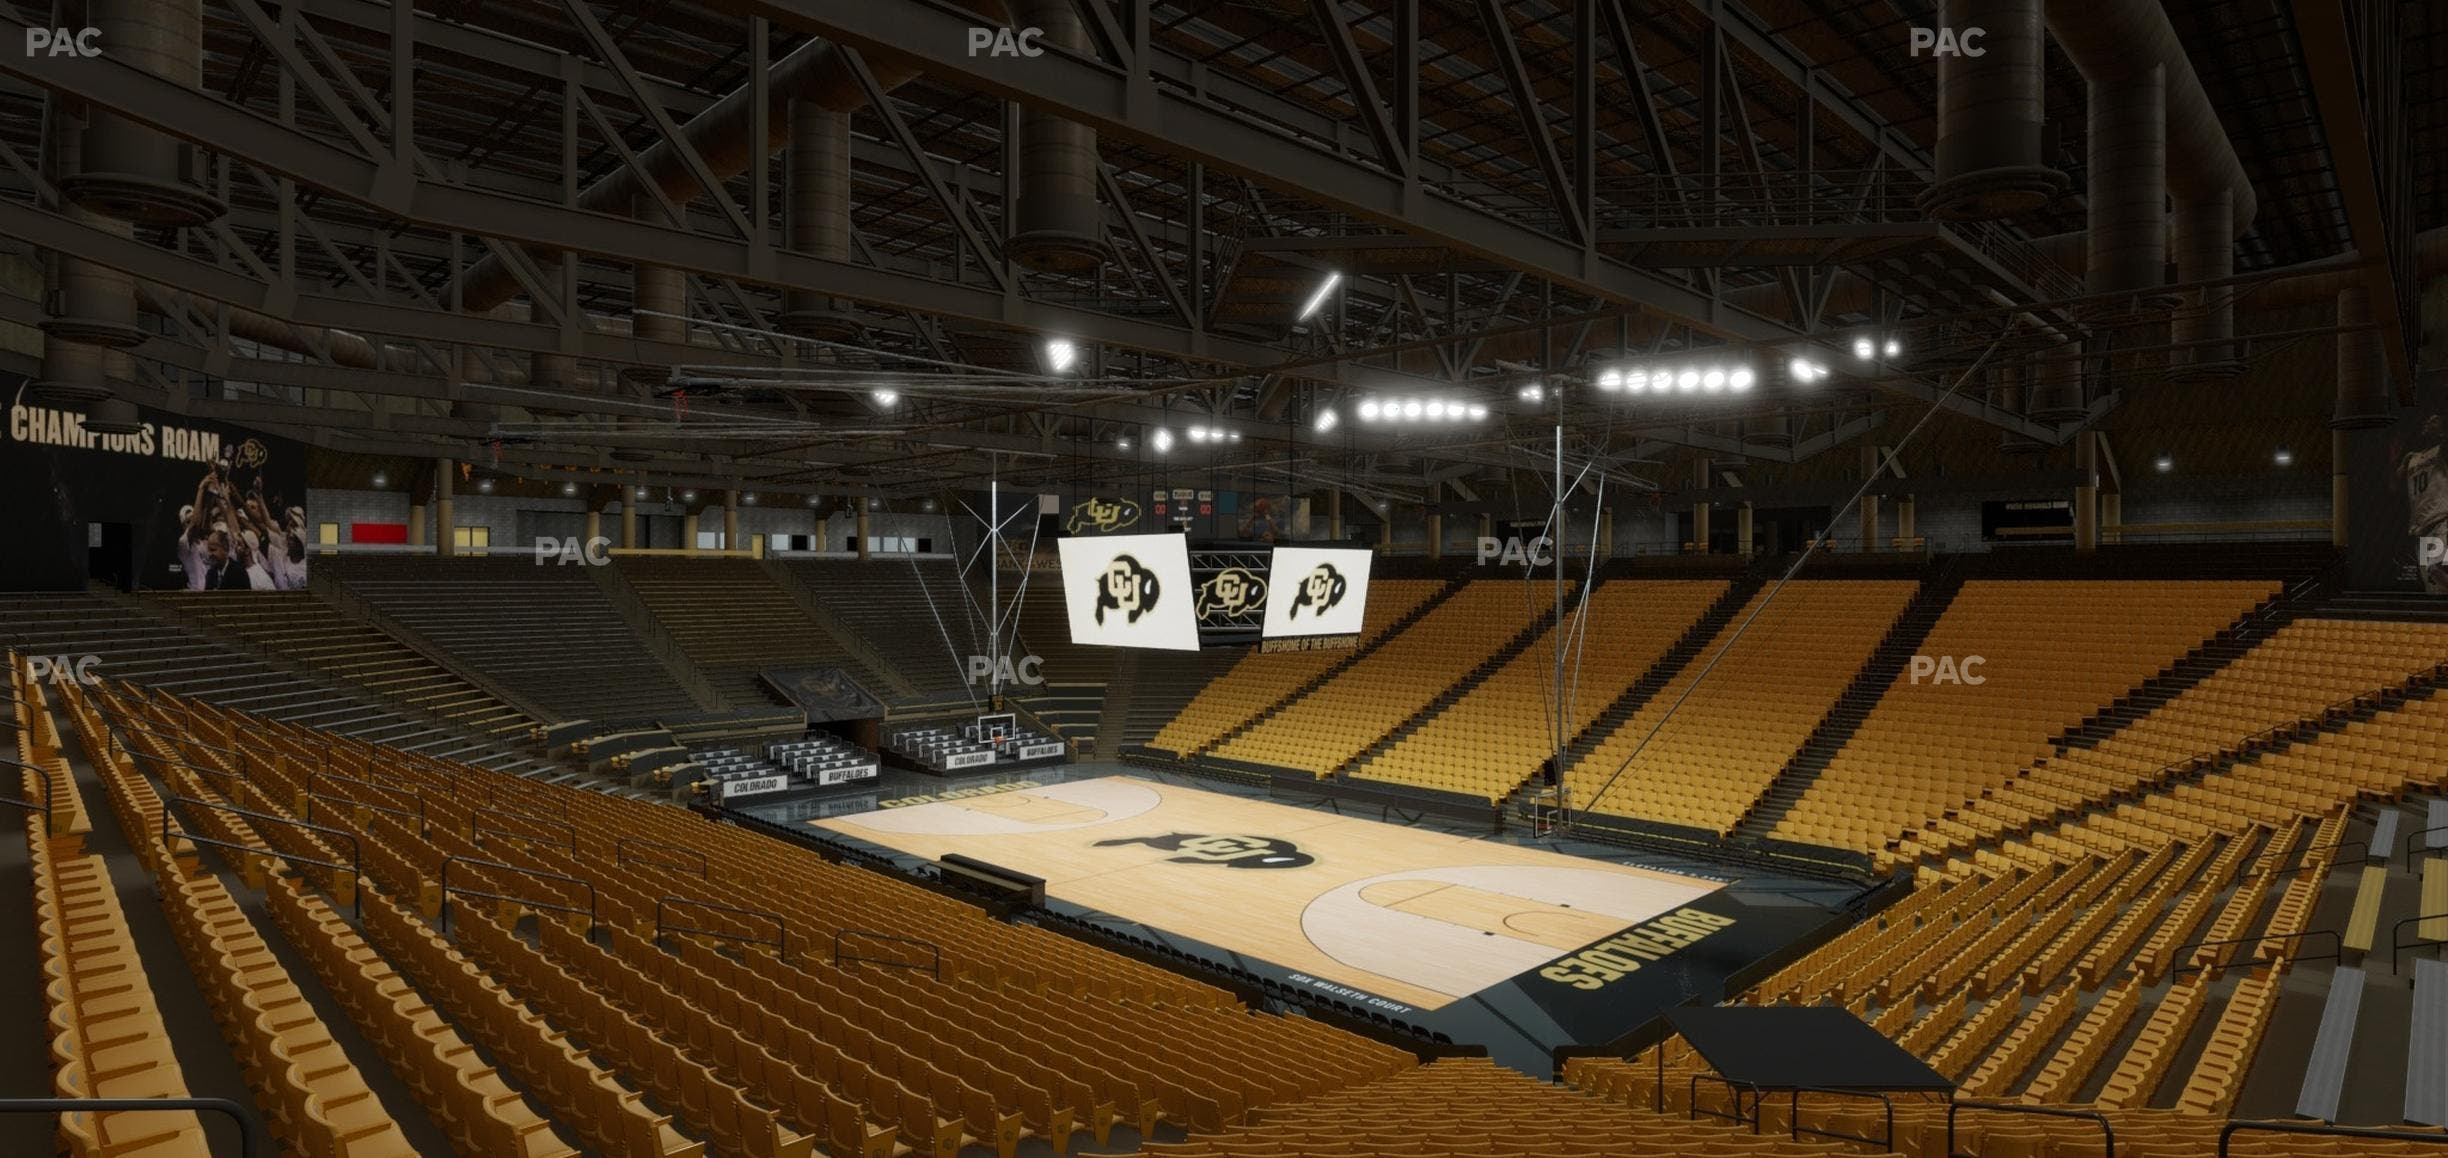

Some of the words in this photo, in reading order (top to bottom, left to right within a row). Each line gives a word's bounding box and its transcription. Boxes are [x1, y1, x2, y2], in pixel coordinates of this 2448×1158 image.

[955, 753, 988, 766] COLORADO
[828, 768, 869, 782] BUFFALOES
[734, 779, 778, 794] COLORADO
[1540, 907, 1737, 990] BUFFALOES
[1288, 974, 1314, 984] SOX
[1313, 981, 1369, 1001] WALSETH
[1368, 997, 1413, 1014] COURT
